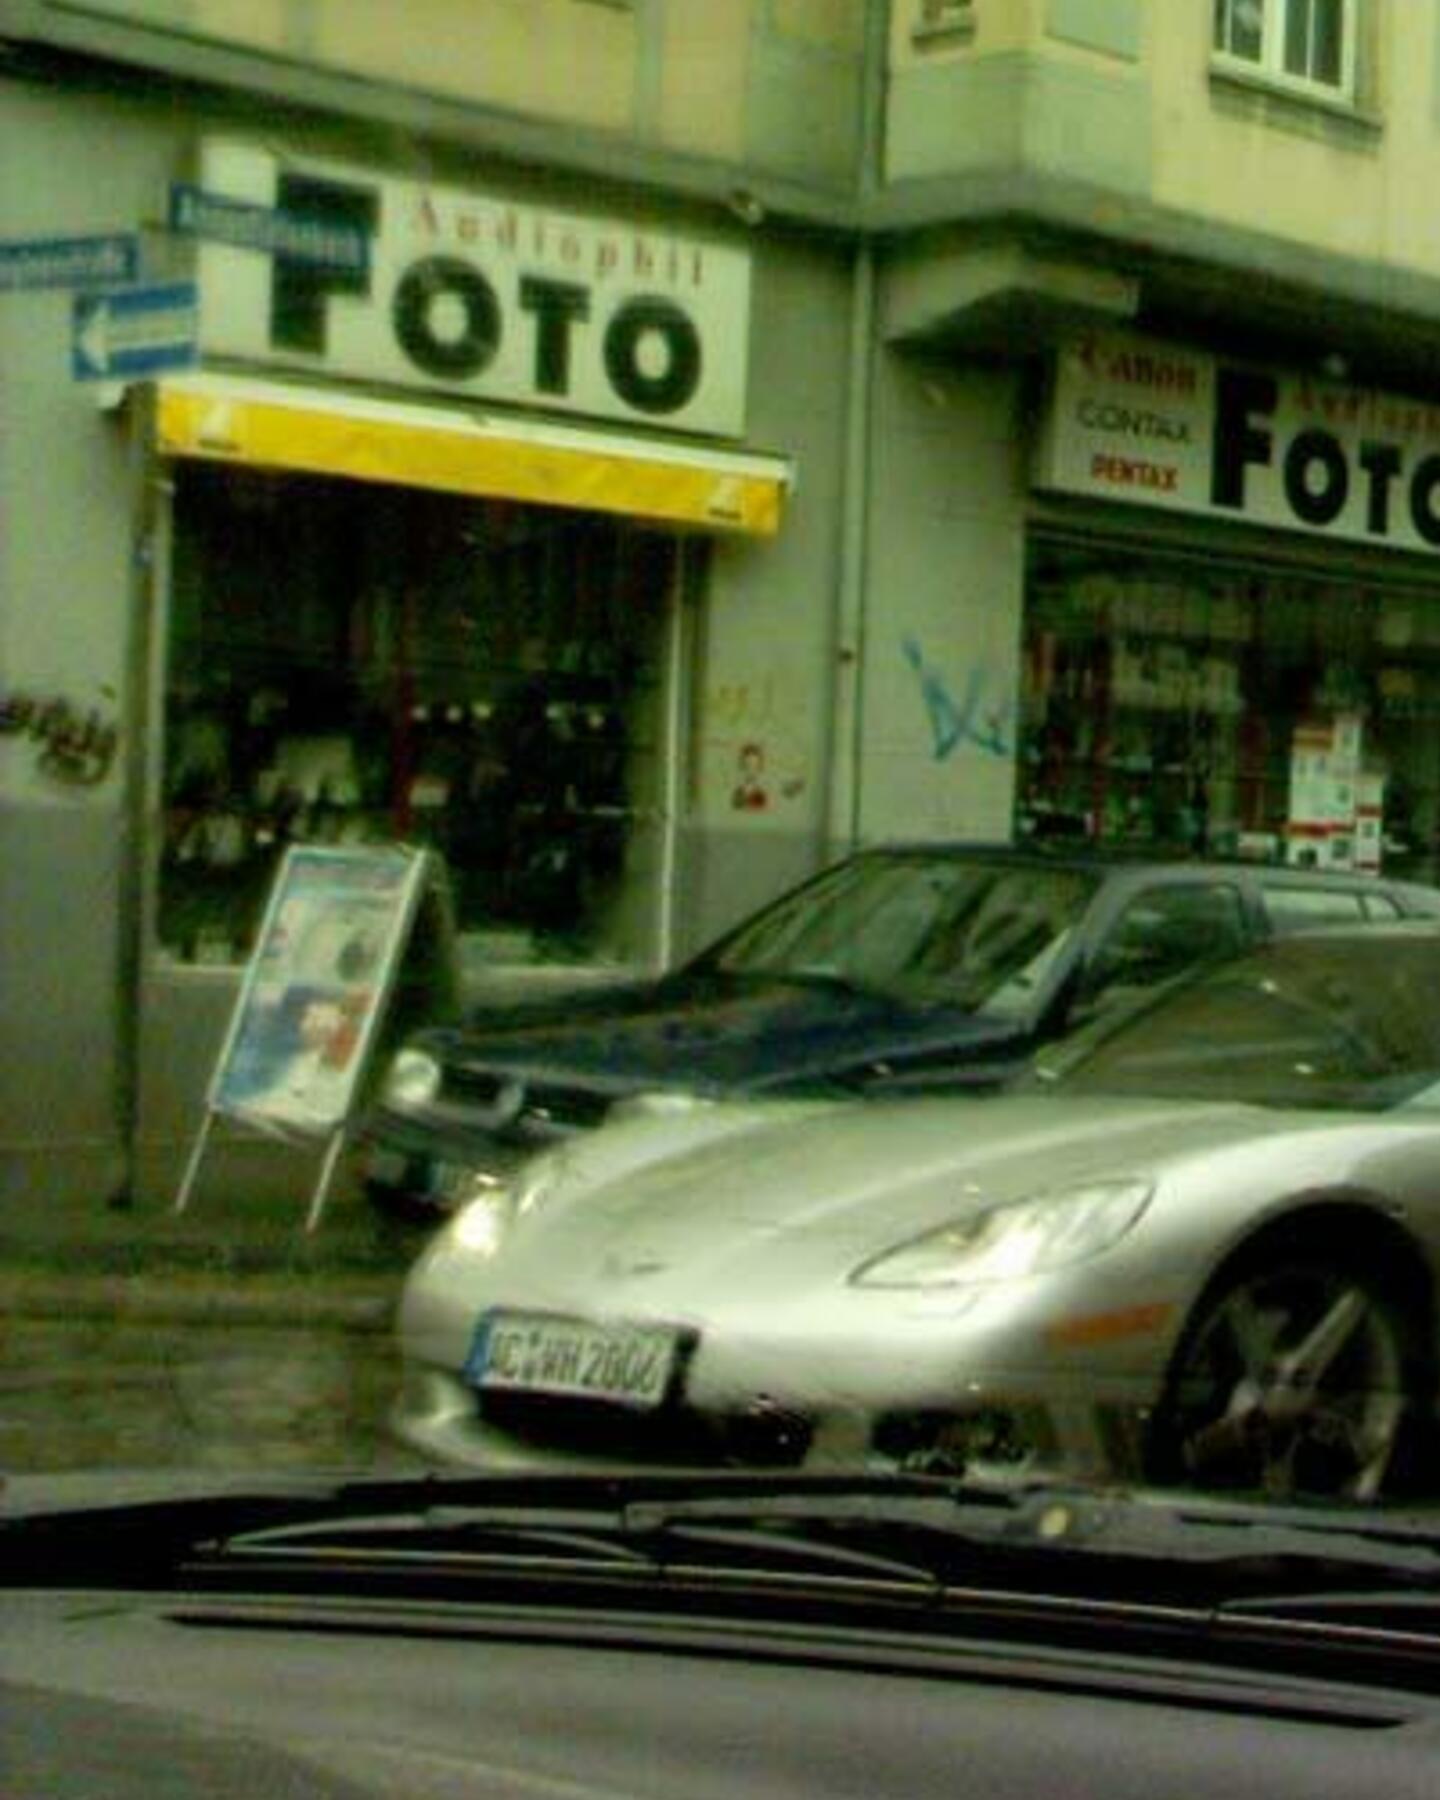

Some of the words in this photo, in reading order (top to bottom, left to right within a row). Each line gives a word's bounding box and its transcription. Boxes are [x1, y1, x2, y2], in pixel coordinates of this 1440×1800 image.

[268, 172, 702, 416] FOTO
[1076, 398, 1190, 446] CONTAX
[1092, 454, 1178, 492] PENTAX
